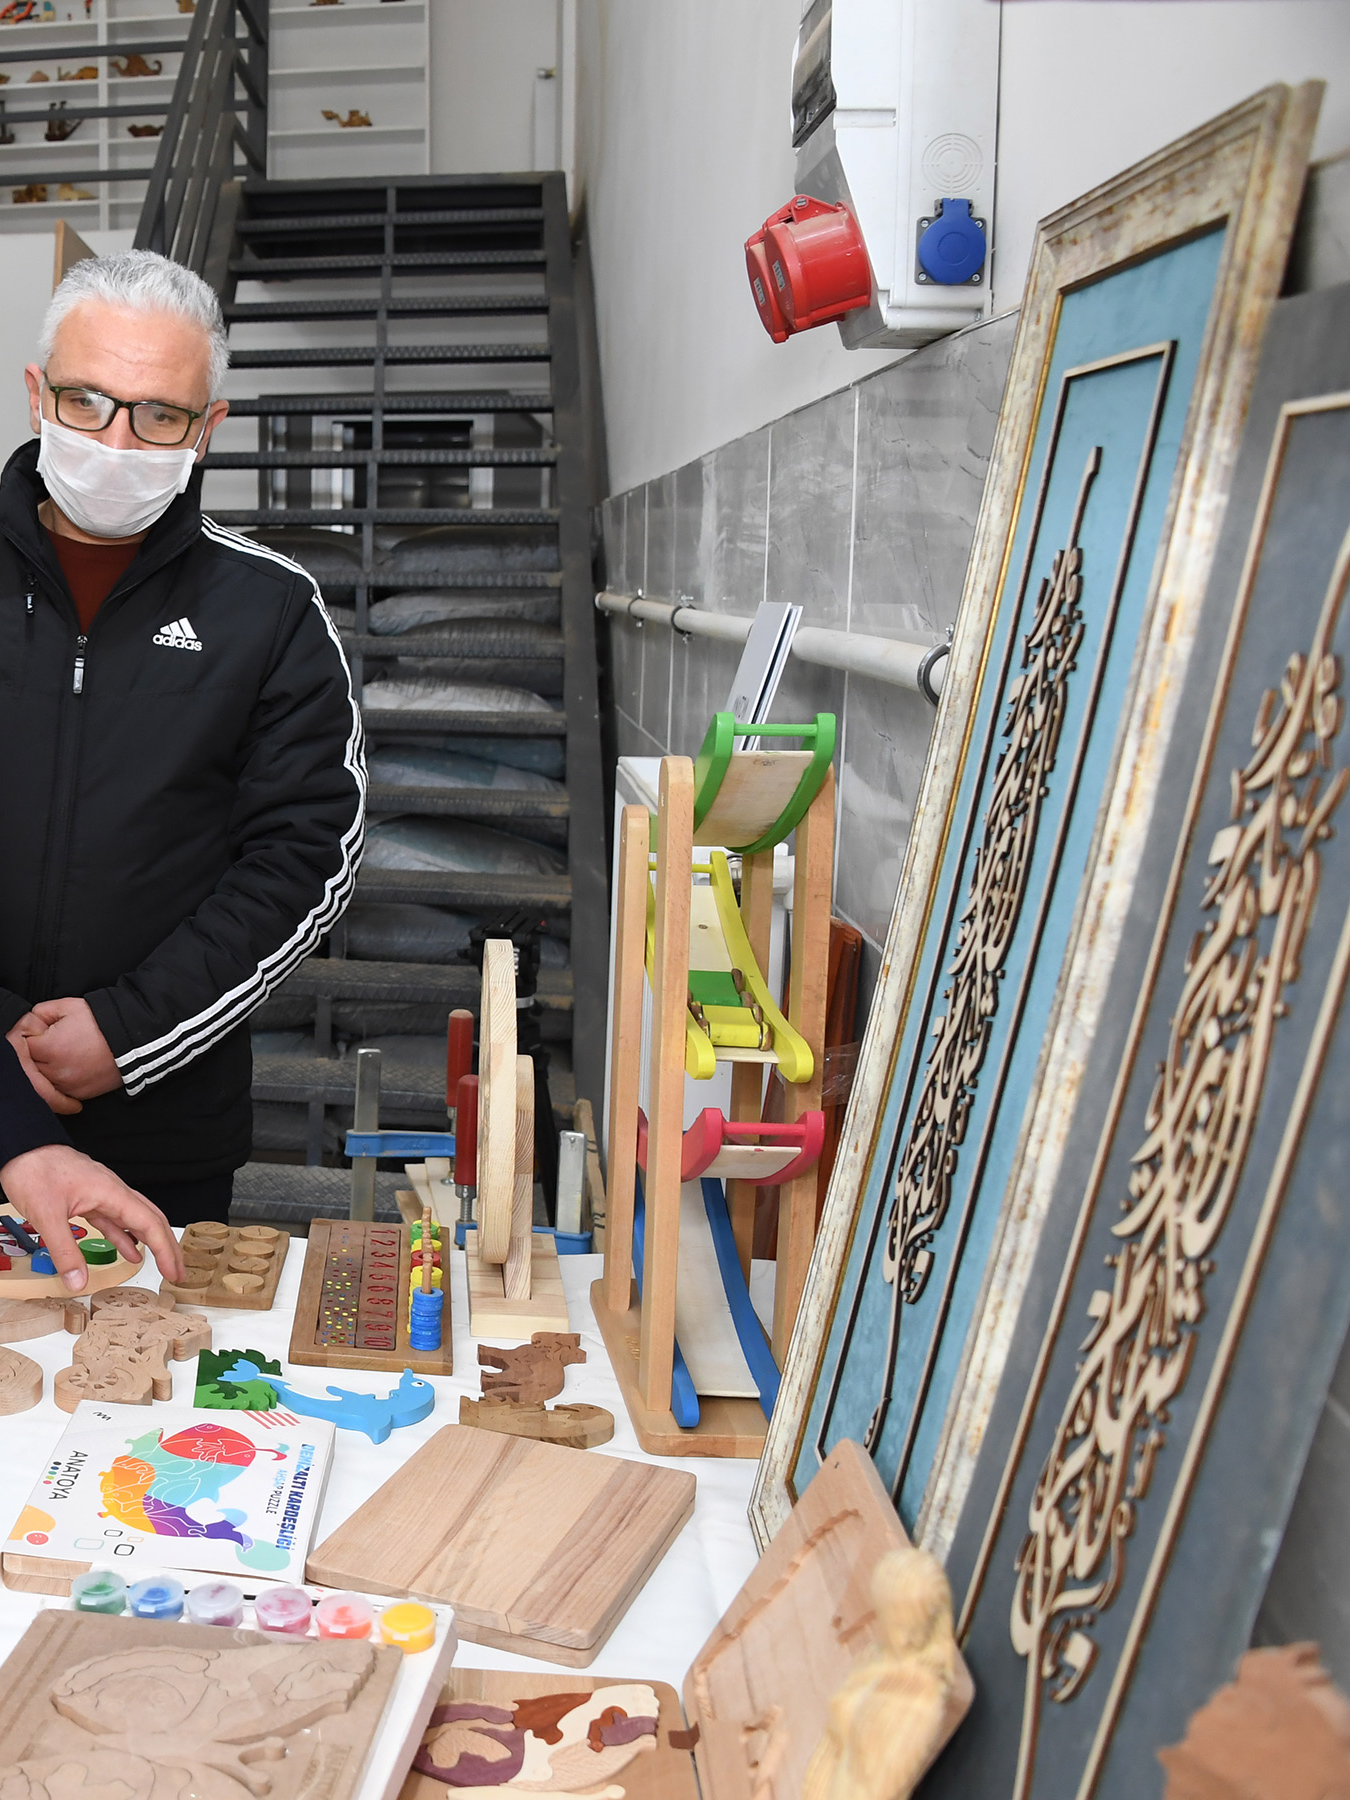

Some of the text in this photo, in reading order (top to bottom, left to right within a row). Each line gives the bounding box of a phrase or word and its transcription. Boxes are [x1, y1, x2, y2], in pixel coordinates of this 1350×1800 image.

[152, 634, 202, 652] adidas
[369, 1261, 395, 1269] 4
[367, 1285, 394, 1293] 6
[366, 1297, 394, 1305] 8
[364, 1323, 393, 1331] 9
[48, 1450, 89, 1500] ANATOYA
[265, 1489, 283, 1514] PUZZLE
[275, 1490, 304, 1550] KARDEŞLİĞİ
